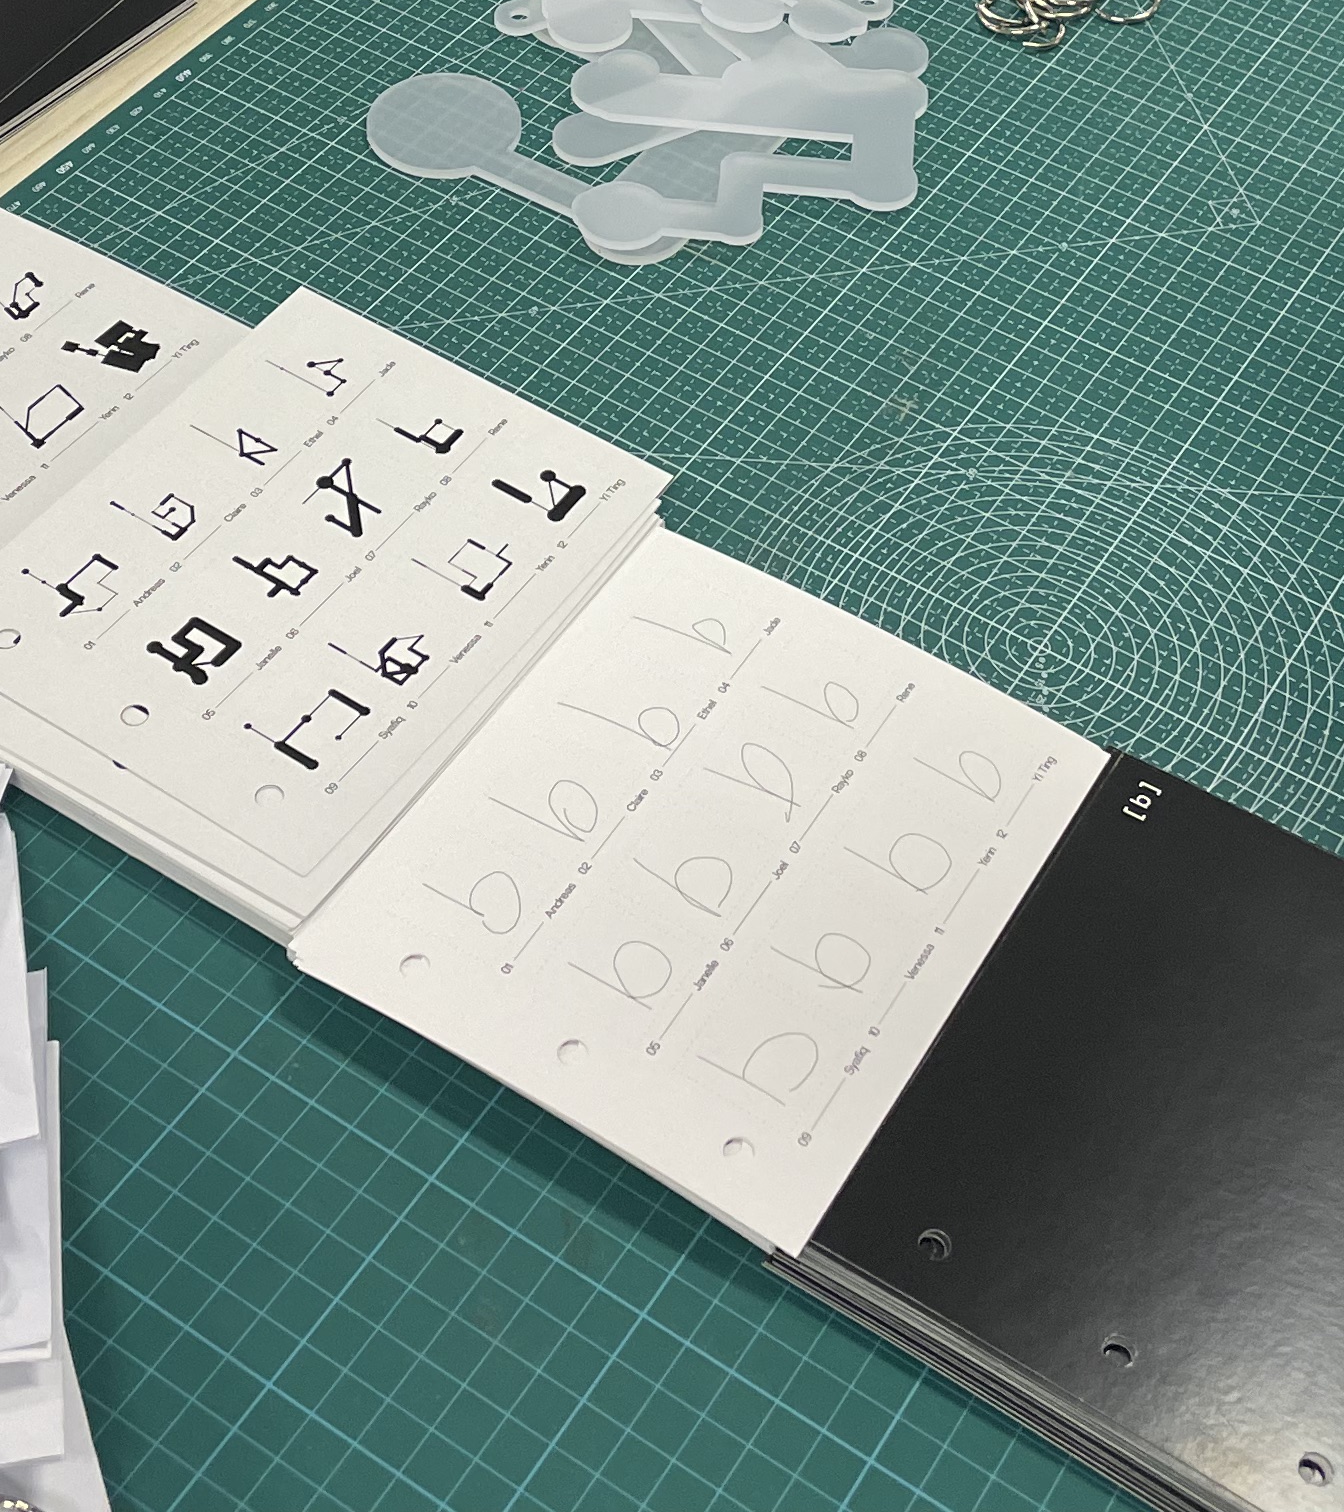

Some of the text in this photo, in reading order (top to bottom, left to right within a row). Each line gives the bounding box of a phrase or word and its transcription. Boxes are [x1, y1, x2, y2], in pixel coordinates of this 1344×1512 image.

[75, 282, 96, 299] Rene
[170, 347, 185, 361] Yi
[180, 338, 201, 356] Ting
[378, 360, 397, 378] Jade
[303, 430, 324, 448] Ethel
[488, 418, 508, 436] Rene
[0, 475, 37, 503] Venessa
[413, 491, 437, 513] Rayko
[598, 490, 612, 504] Yi
[606, 478, 627, 497] Ting
[223, 503, 247, 523] Claire
[344, 566, 362, 584] Joel
[132, 578, 166, 608] Andreas
[255, 645, 283, 671] Janelle
[449, 634, 483, 665] Venessa
[717, 617, 782, 694] 04 Jade
[378, 715, 406, 741] Syafiq
[853, 682, 916, 763] 08 Rene
[649, 699, 718, 782] 03 Ethel
[789, 768, 854, 855] 07 Rayko
[996, 755, 1058, 840] 12 Yi Ting
[577, 788, 649, 875] 02 Claire
[719, 860, 789, 952] 06 Joel
[500, 883, 577, 975] 01 Andreas
[934, 925, 946, 936] 11
[868, 943, 935, 1038] 10 Venessa
[645, 960, 719, 1057] 05 Janelle
[797, 1046, 871, 1148] 09 Syafiq
